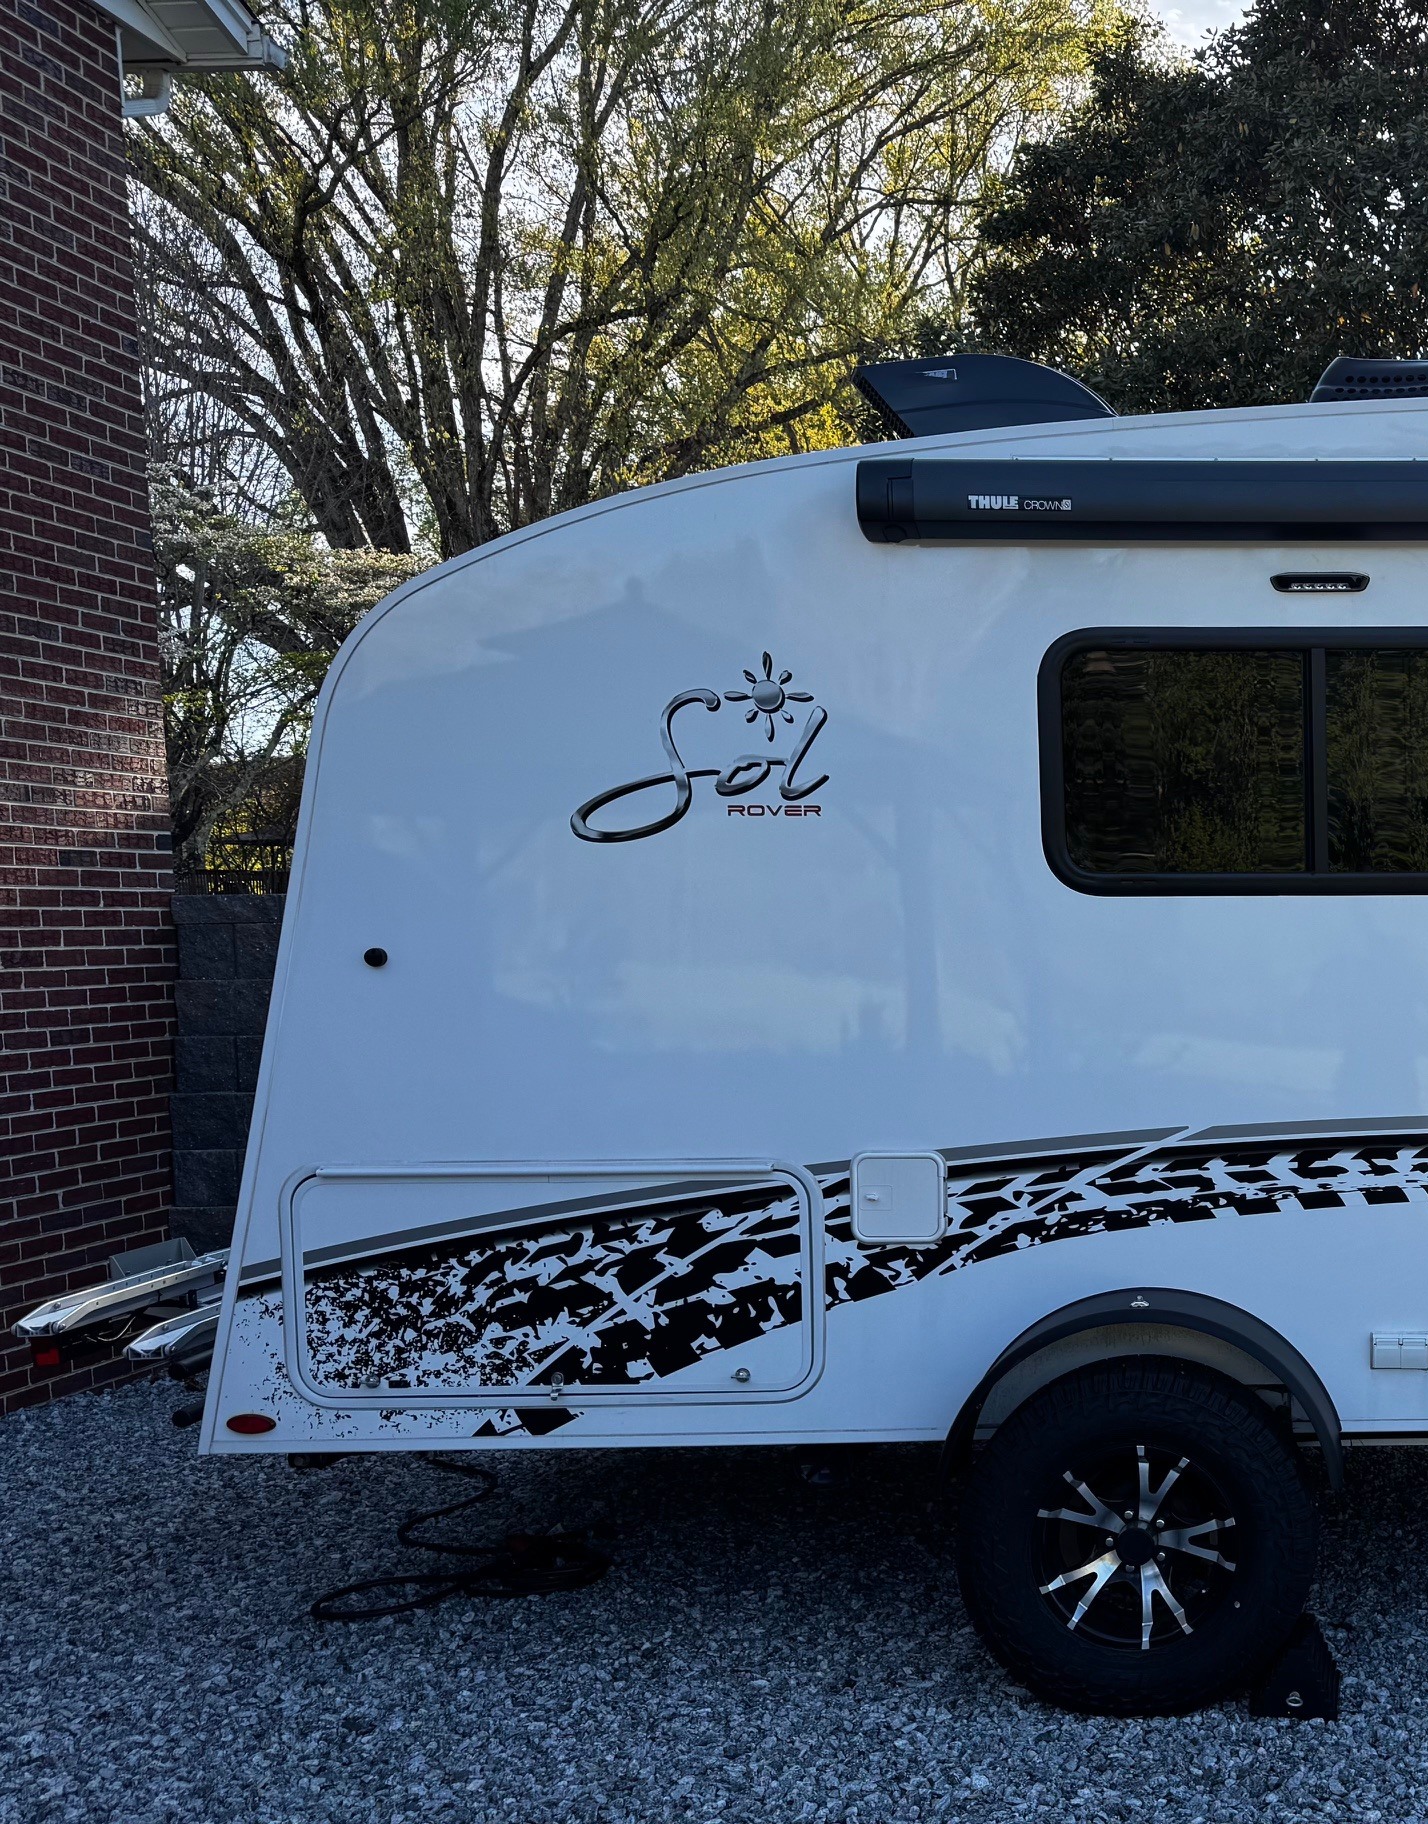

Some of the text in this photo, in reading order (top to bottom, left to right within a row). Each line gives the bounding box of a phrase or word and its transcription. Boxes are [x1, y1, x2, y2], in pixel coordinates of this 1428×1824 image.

[968, 495, 1019, 509] THULE
[570, 688, 830, 843] Sol
[727, 805, 822, 816] ROVER
